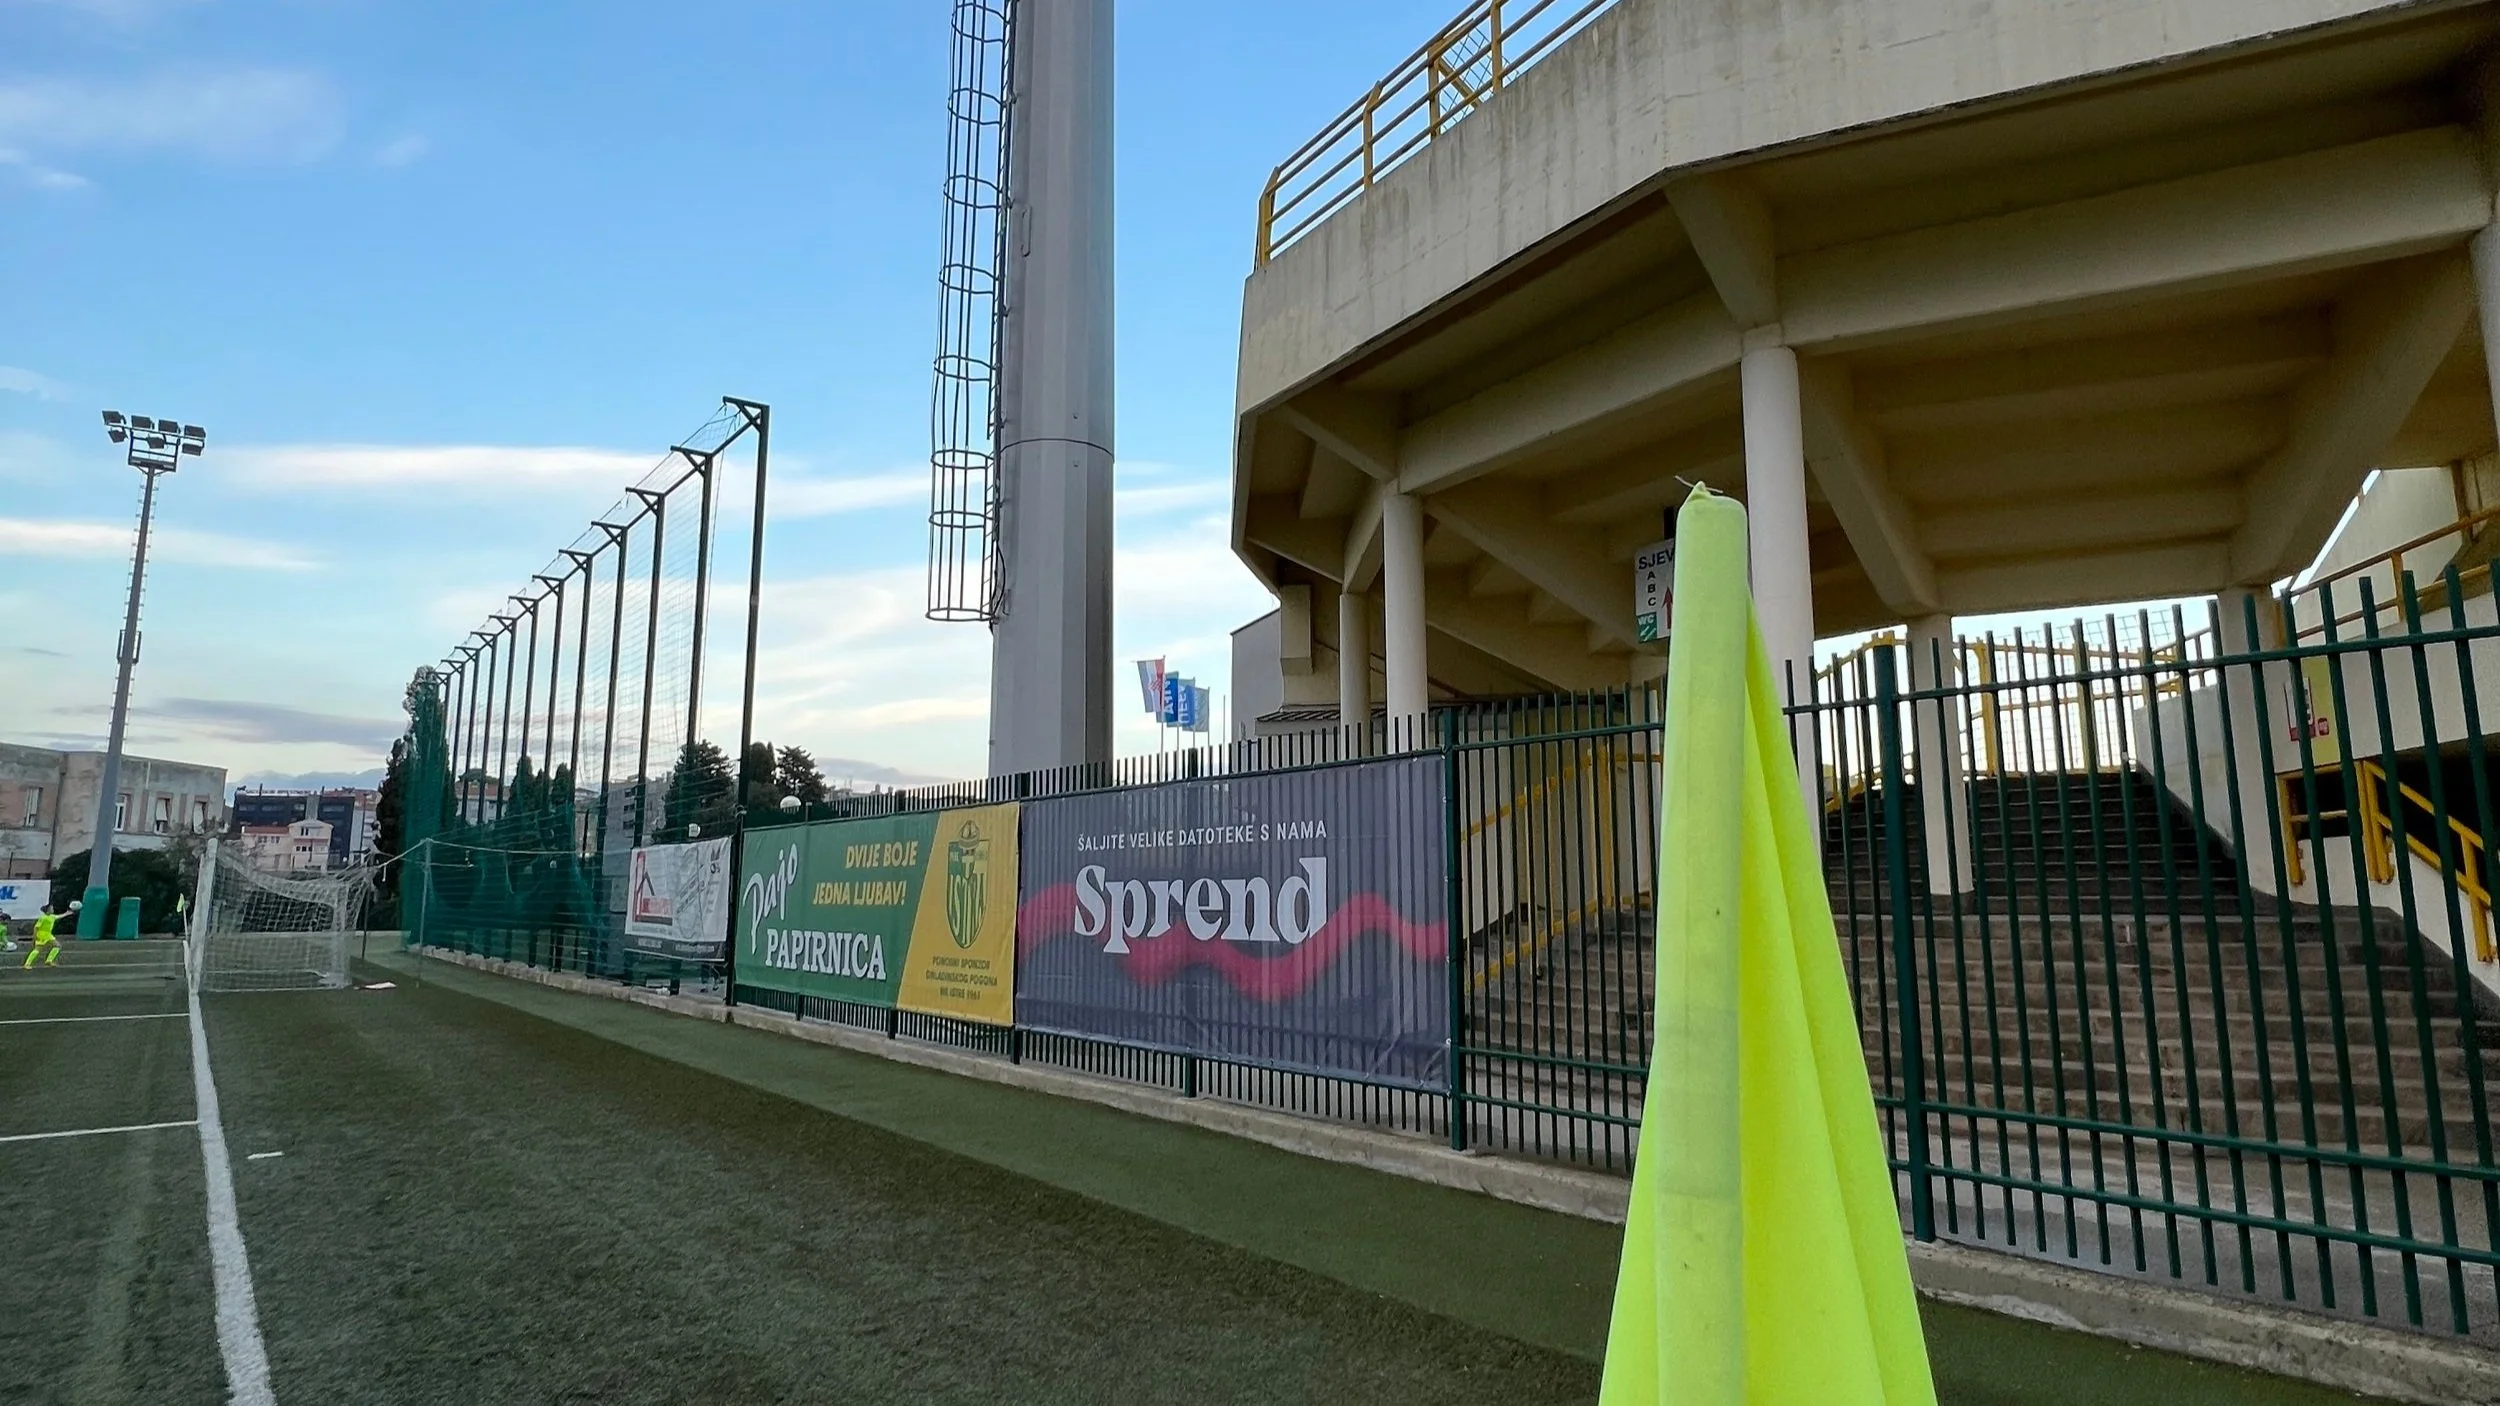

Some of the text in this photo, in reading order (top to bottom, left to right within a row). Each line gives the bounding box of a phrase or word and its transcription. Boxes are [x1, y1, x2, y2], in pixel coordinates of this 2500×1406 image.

[1647, 571, 1656, 580] A
[1647, 584, 1656, 593] B
[1648, 597, 1656, 606] C
[1638, 614, 1654, 625] WC
[1078, 820, 1327, 851] ŠALJITE VELIKE DATOTEKE S NAMA
[845, 841, 919, 868] DVIJE BOJE
[813, 880, 907, 905] JEDNA LJUBAV!
[1074, 857, 1327, 954] Sprend
[765, 928, 887, 980] PAPIRNICA
